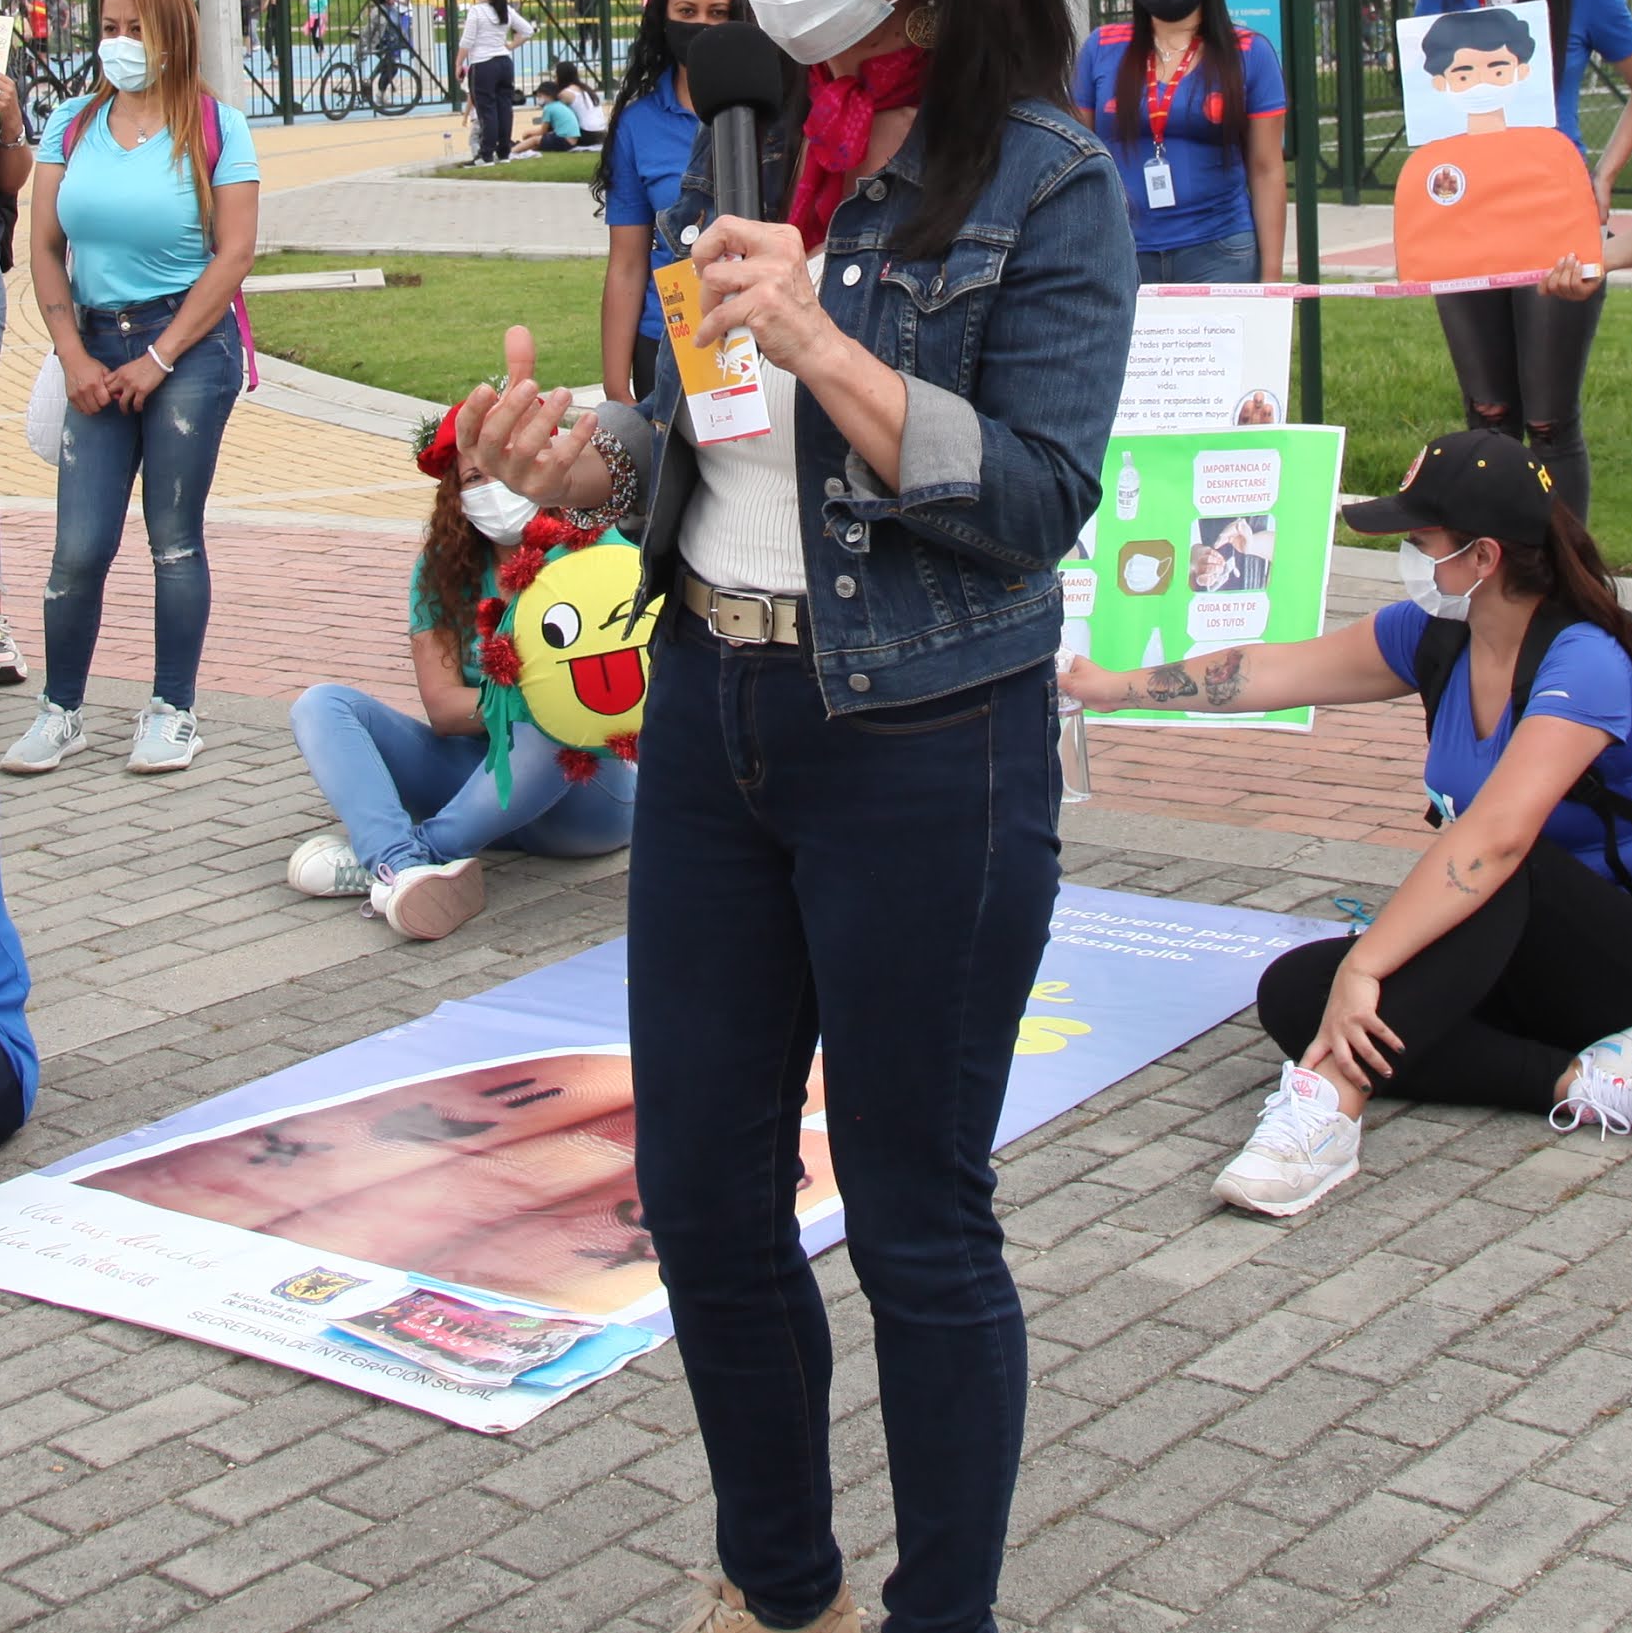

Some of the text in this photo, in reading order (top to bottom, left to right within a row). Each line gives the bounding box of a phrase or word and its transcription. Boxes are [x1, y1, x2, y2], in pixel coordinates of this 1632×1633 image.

[1178, 326, 1200, 335] social
[1204, 326, 1236, 335] funciona
[1162, 340, 1212, 350] participamos
[1129, 355, 1162, 364] Disminuir
[1173, 355, 1206, 365] prevenir
[1161, 368, 1173, 377] del
[1139, 397, 1161, 405] somos
[1164, 396, 1211, 407] responsables
[1213, 396, 1224, 405] de
[1150, 410, 1160, 418] los
[1163, 412, 1175, 420] que
[1205, 411, 1229, 420] mayor
[1202, 462, 1271, 473] IMPORTANCIA DE
[1206, 478, 1266, 489] DESINFECTARSE
[1199, 492, 1271, 504] CONSTANTEMENTE
[1197, 603, 1220, 613] CUIDA
[1222, 603, 1232, 612] DE
[1233, 603, 1240, 612] TI
[1246, 602, 1256, 611] DE
[1207, 618, 1245, 628] LOS TUYOS
[1070, 921, 1266, 959] discapacidad y
[1194, 928, 1259, 944] para
[1265, 935, 1293, 949] la
[1052, 934, 1194, 961] desarrollo.
[19, 1202, 220, 1270] Vive tus derechos
[35, 1243, 71, 1260] la
[221, 1298, 239, 1307] DE
[288, 1337, 315, 1352] DE
[430, 1378, 496, 1402] SOCIAL
